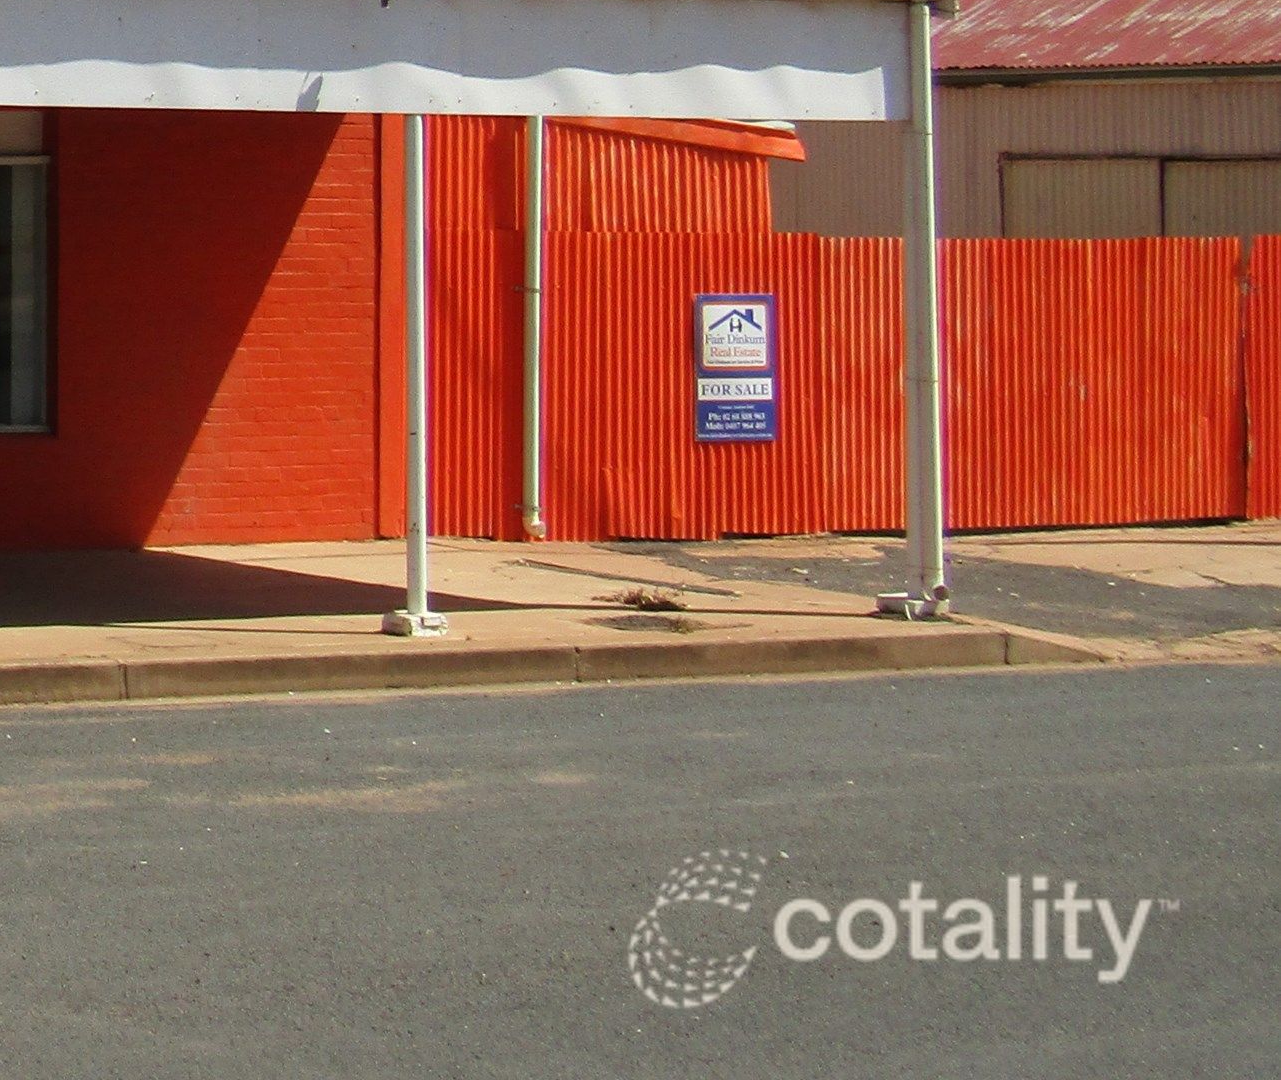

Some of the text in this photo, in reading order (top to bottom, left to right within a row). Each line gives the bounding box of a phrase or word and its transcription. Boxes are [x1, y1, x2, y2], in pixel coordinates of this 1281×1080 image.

[705, 333, 767, 344] Fair Dinkum
[710, 347, 761, 357] Real Estate
[701, 384, 769, 396] FOR SALE
